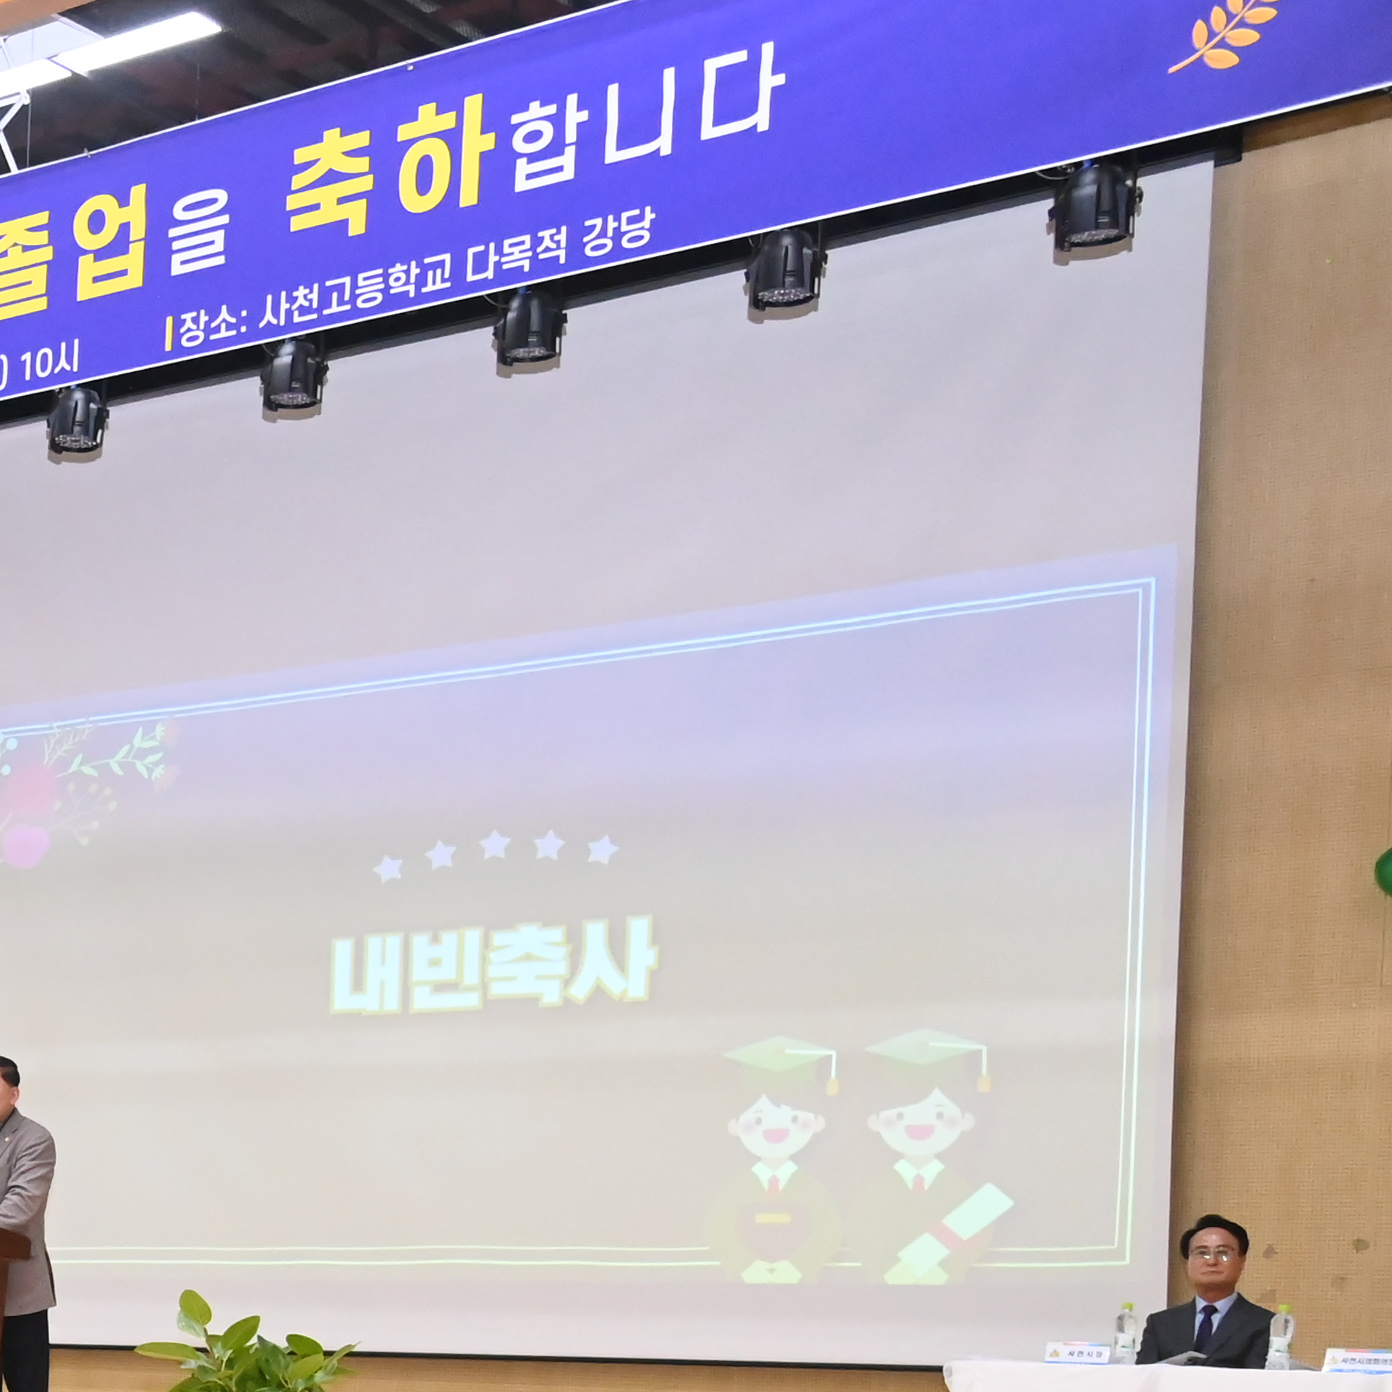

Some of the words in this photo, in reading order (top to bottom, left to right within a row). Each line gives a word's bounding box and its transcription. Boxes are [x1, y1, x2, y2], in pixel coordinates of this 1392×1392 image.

[285, 40, 786, 237] 축하합니다
[179, 304, 248, 348] 장소:
[258, 252, 452, 329] 사천고등학교
[465, 225, 567, 283] 다목적
[582, 205, 657, 257] 강당
[20, 338, 80, 381] 10시
[330, 914, 659, 1015] 내빈축사
